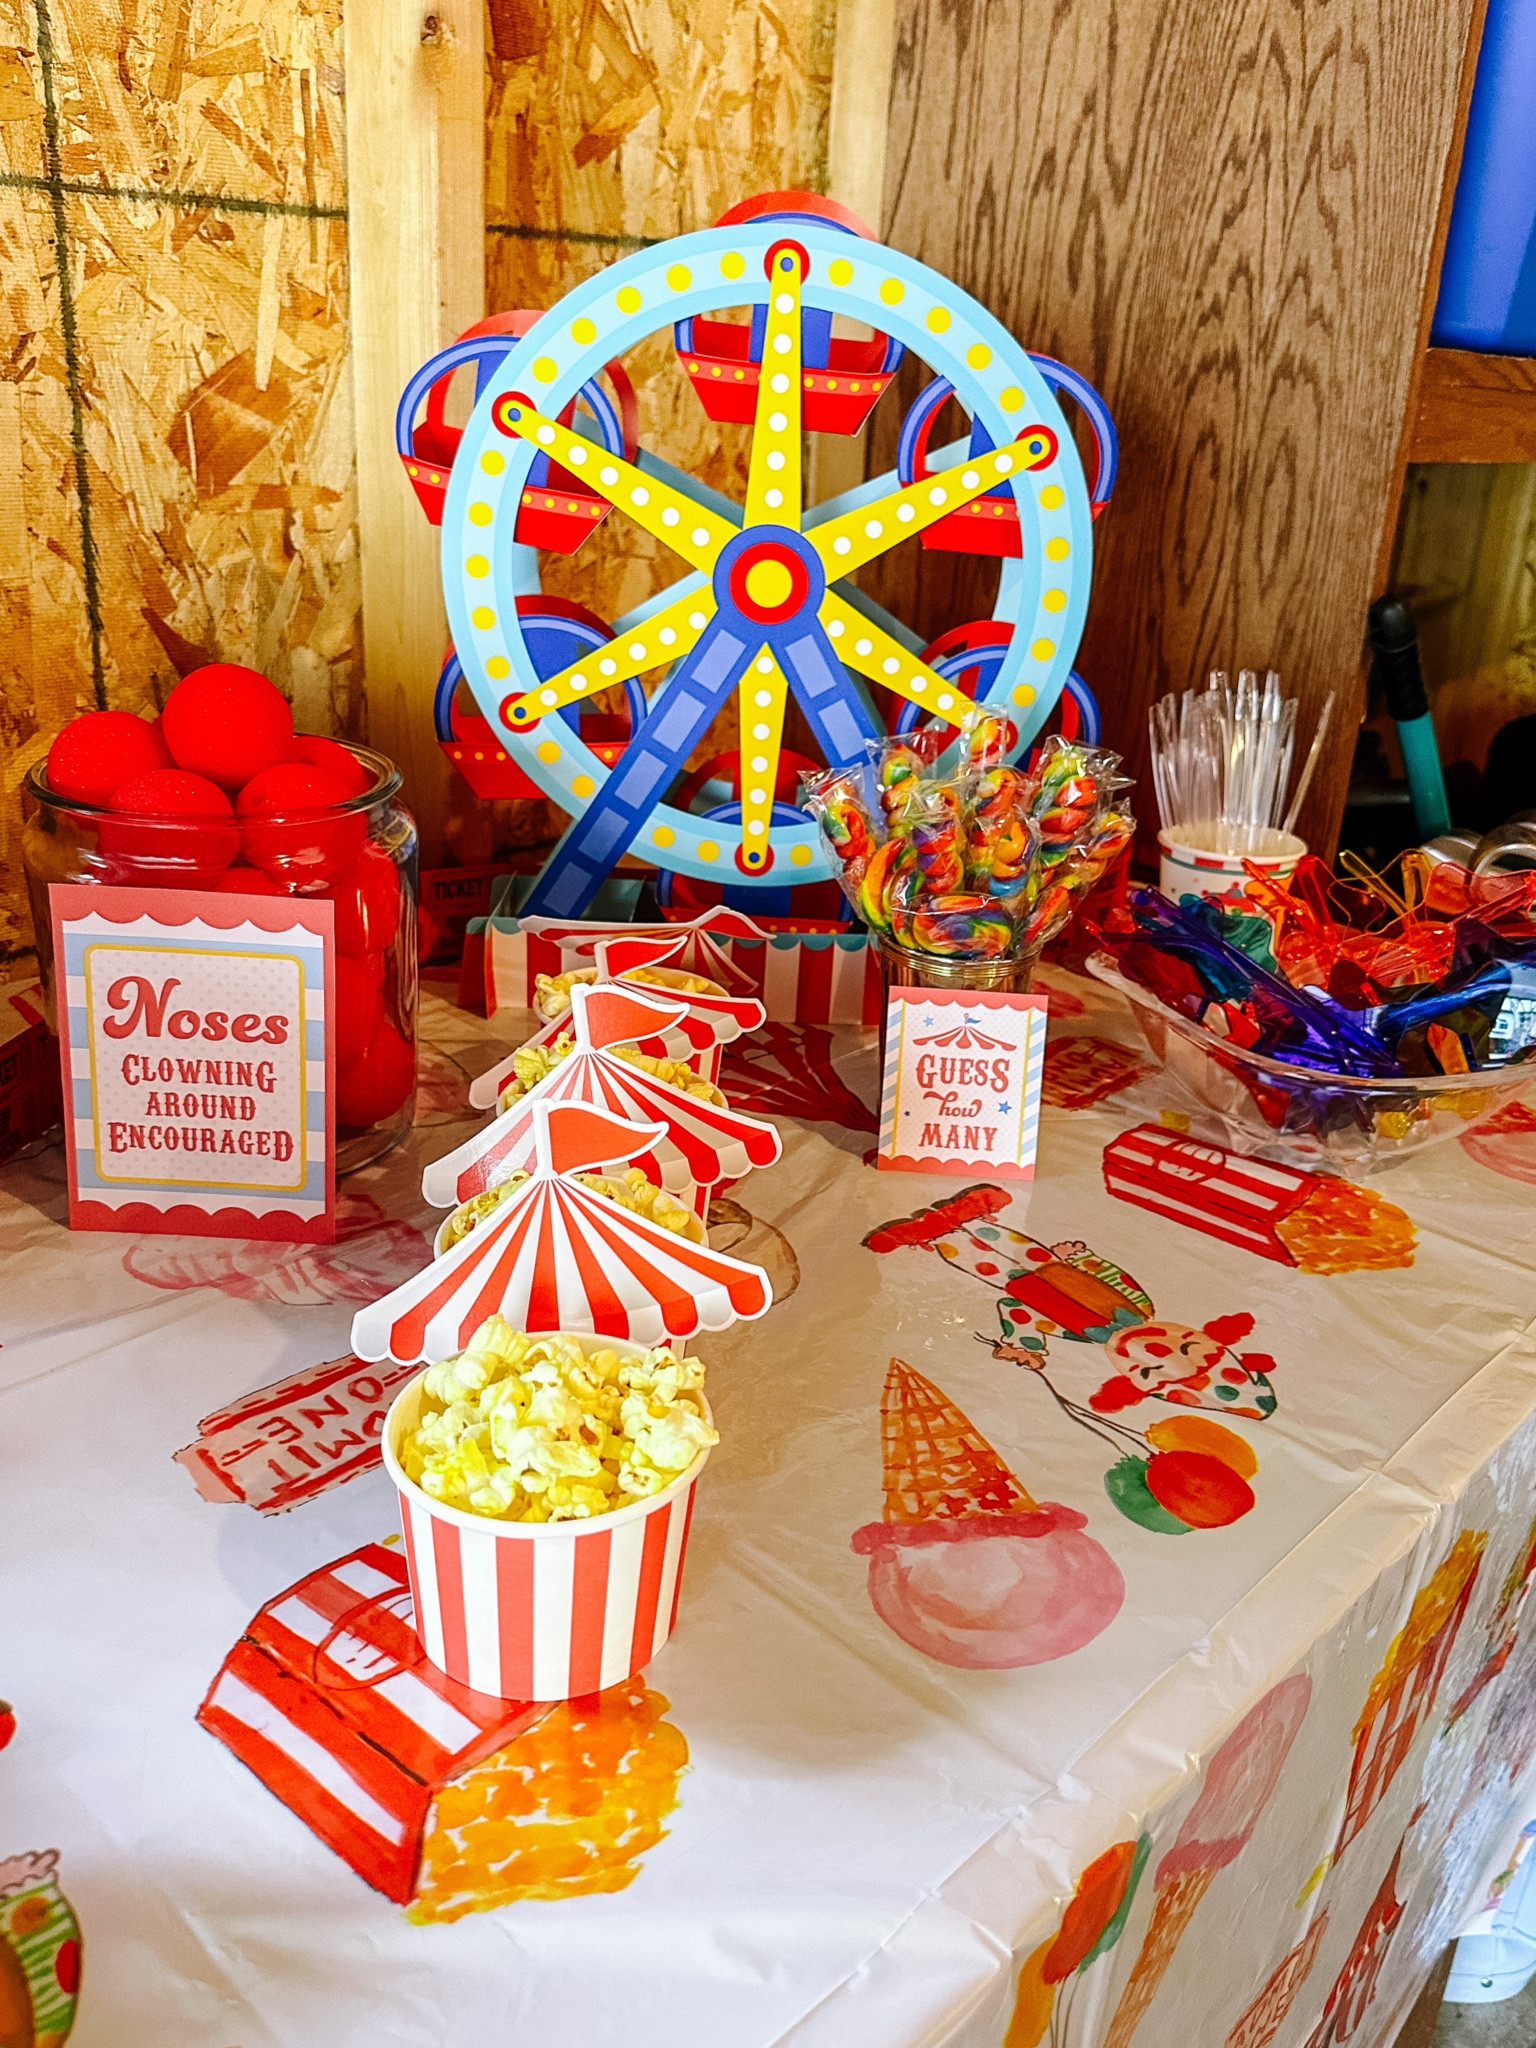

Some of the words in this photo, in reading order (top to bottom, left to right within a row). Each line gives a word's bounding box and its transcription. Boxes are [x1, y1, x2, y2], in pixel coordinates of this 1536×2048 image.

[433, 877, 485, 902] TICKET
[102, 975, 290, 1045] Noses
[121, 1053, 278, 1094] CLOWNING
[916, 1053, 1011, 1093] GUESS
[145, 1091, 257, 1121] AROUND
[923, 1091, 983, 1118] how
[107, 1121, 295, 1162] ENCOURAGED
[918, 1122, 999, 1152] MANY
[257, 1375, 385, 1445] ONE
